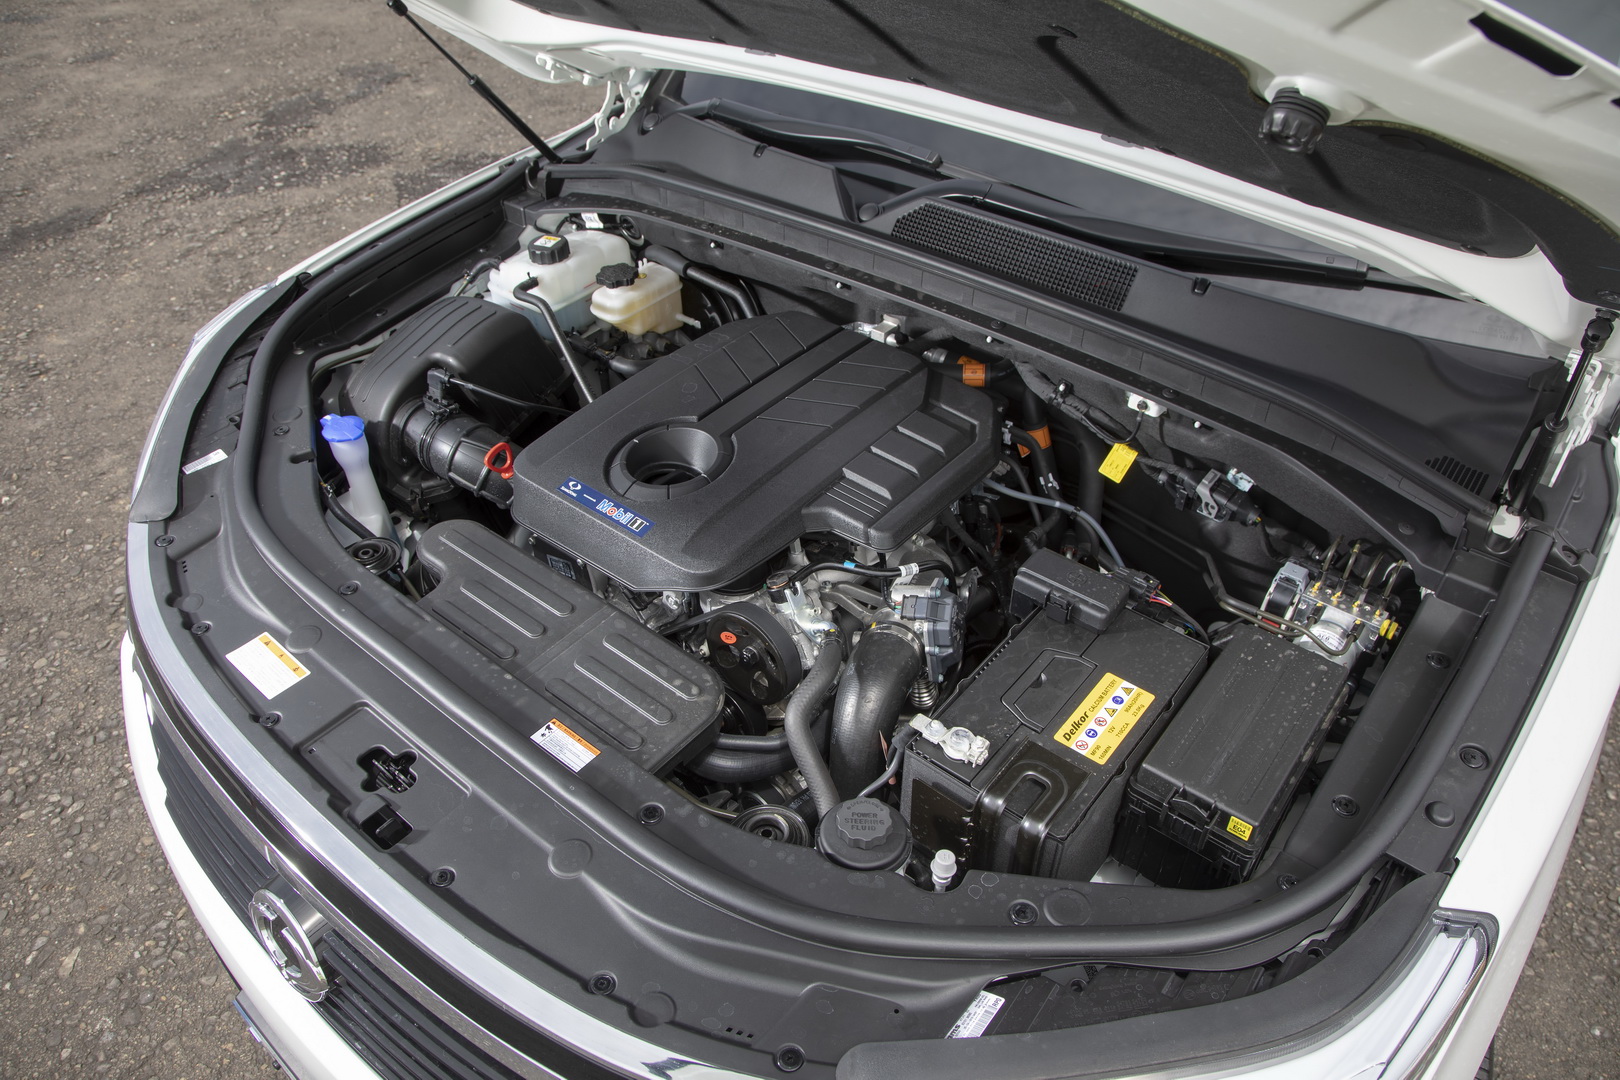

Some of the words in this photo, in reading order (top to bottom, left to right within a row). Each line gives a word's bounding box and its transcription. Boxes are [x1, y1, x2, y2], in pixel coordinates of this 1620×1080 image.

[596, 499, 634, 525] Mobil
[1062, 711, 1089, 742] Delkor
[1089, 694, 1105, 713] CALCIUM
[1101, 679, 1118, 696] BATTERY
[1107, 725, 1116, 734] 12V
[844, 818, 885, 826] STEERING
